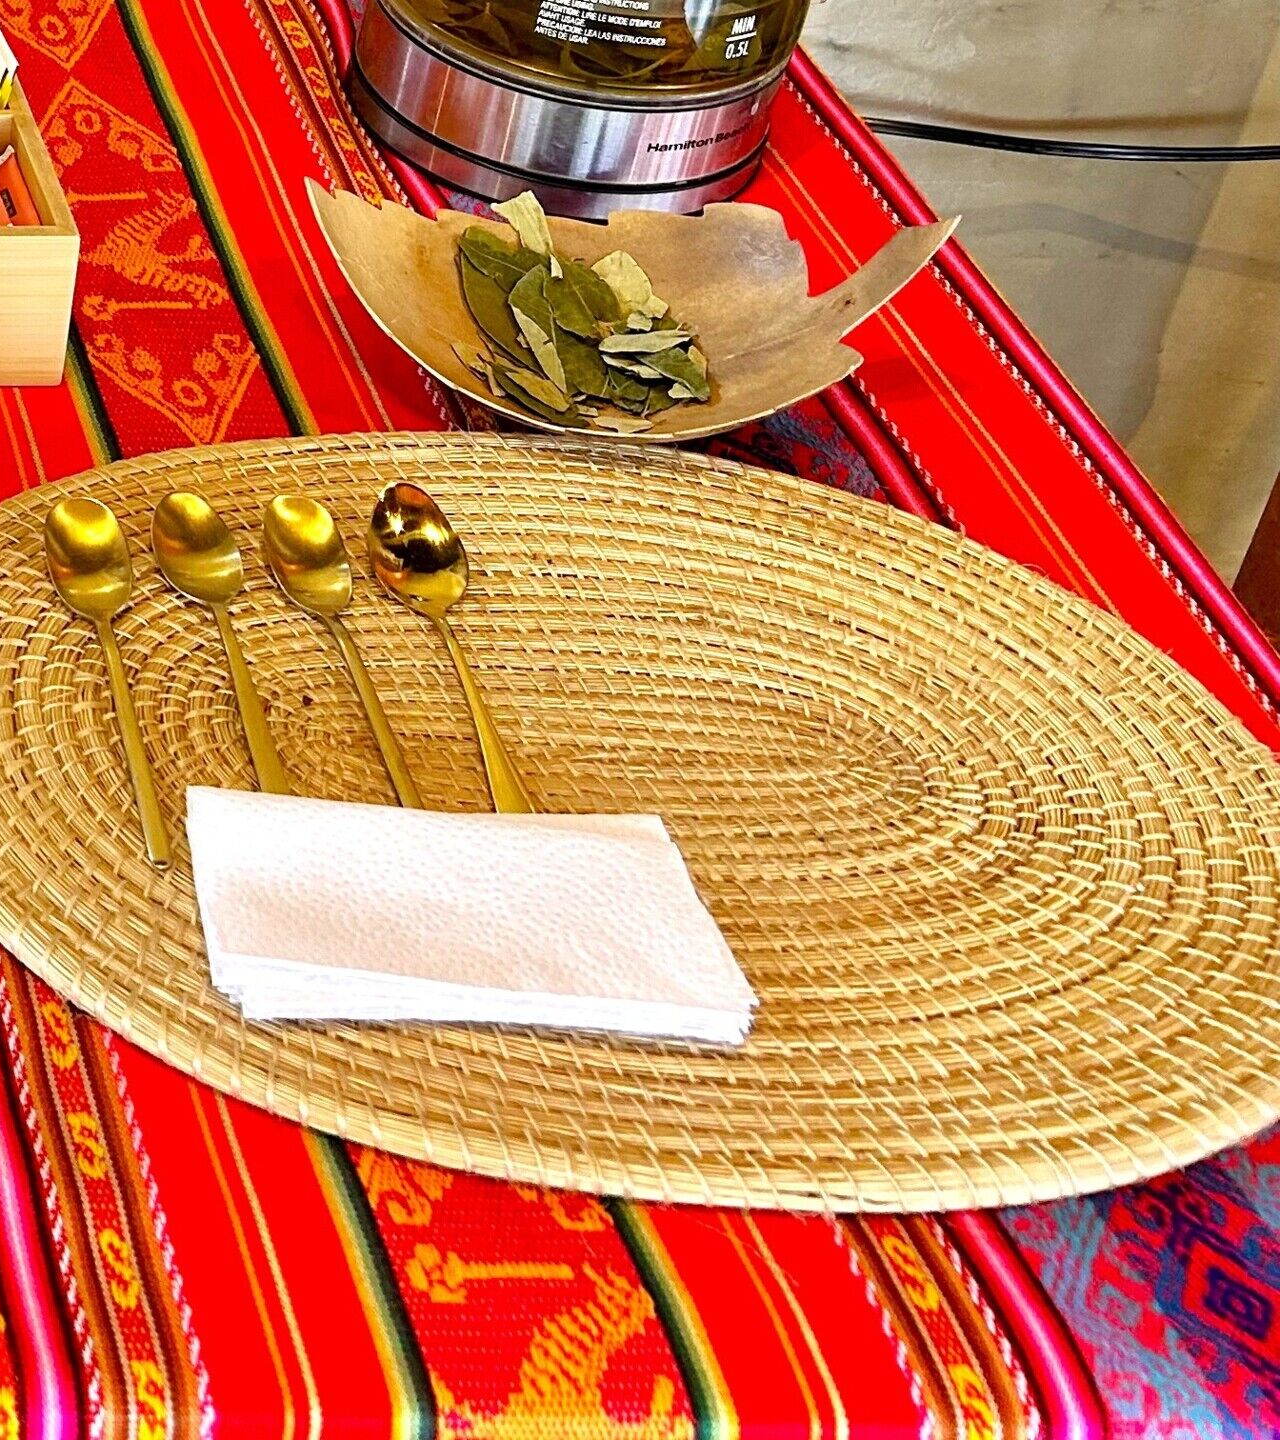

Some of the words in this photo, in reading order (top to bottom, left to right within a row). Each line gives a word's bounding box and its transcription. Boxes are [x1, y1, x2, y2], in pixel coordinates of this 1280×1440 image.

[598, 13, 607, 22] LE
[731, 15, 756, 35] MIN
[725, 41, 749, 60] 0.5L
[646, 137, 713, 153] Hamilton
